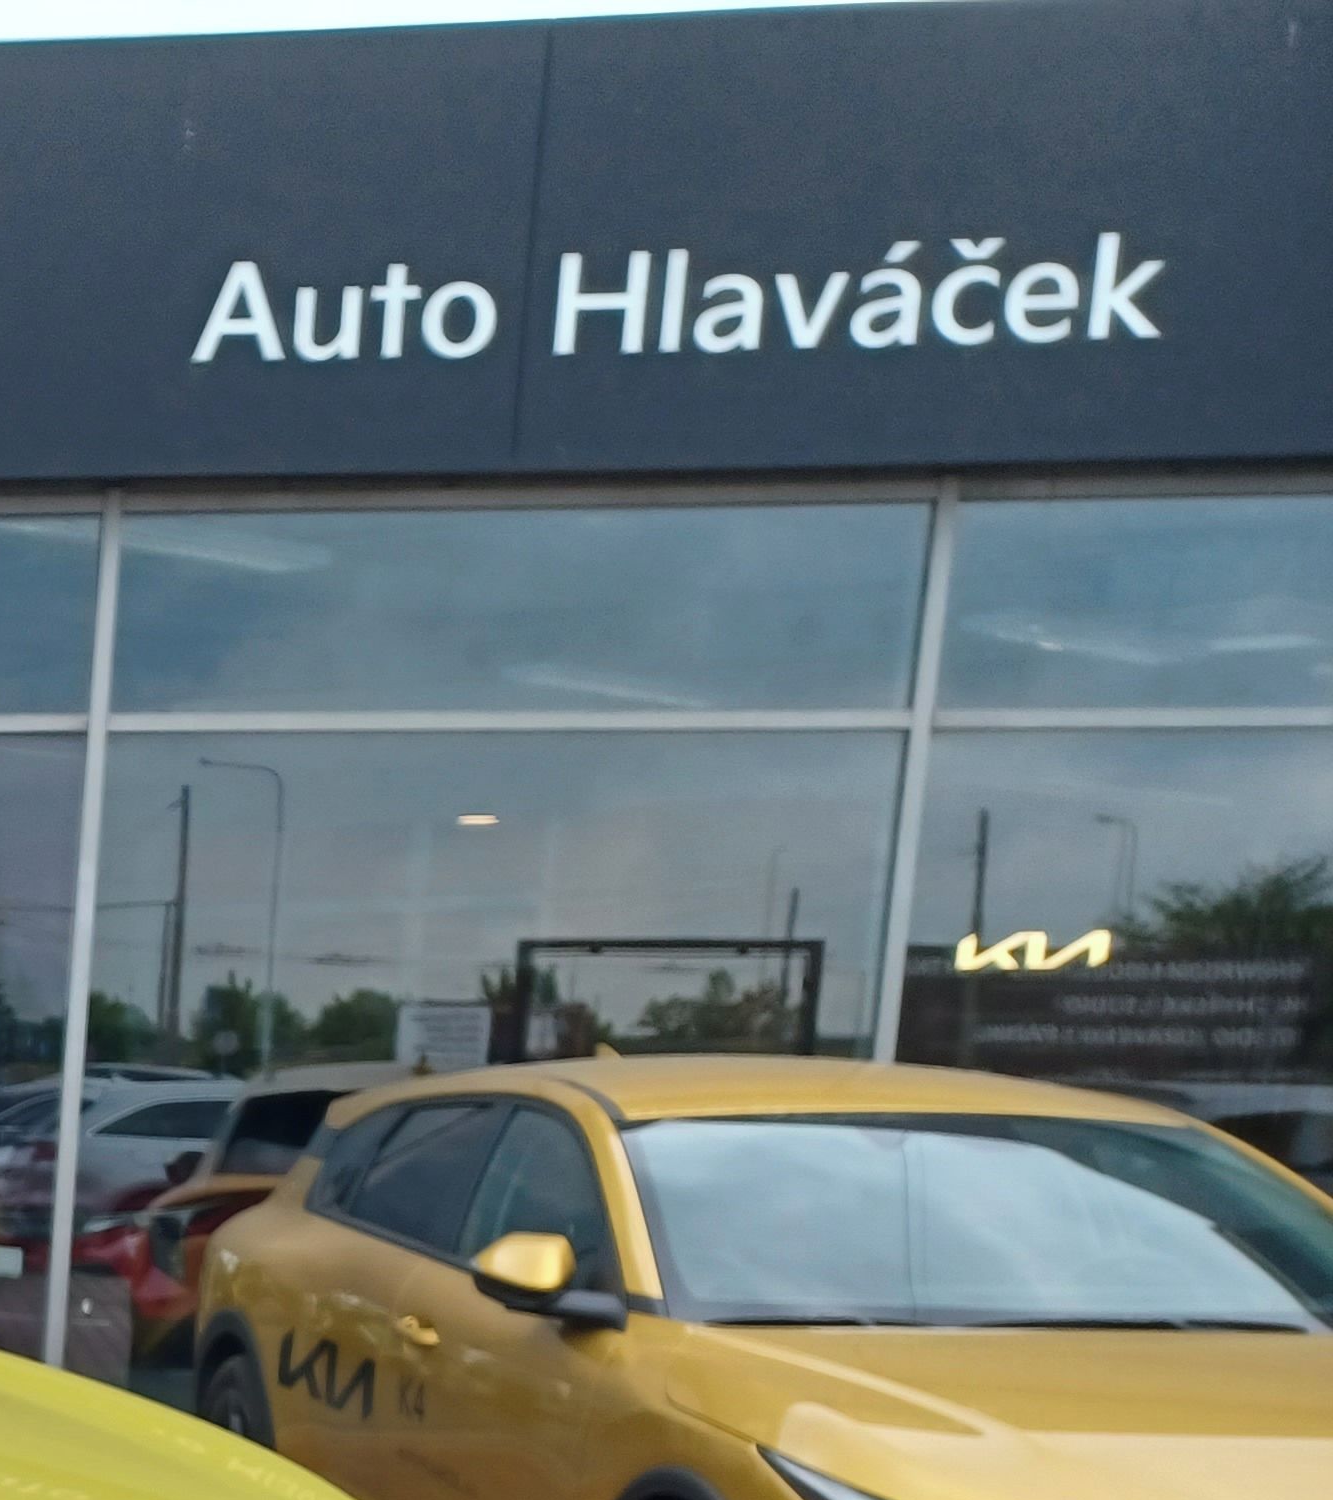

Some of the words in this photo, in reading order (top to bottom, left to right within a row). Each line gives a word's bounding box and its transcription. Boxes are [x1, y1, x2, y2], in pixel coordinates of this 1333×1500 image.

[192, 262, 496, 362] Auto
[553, 232, 1163, 355] Hlaváček
[955, 929, 1111, 971] KIA
[277, 1327, 376, 1421] KIA
